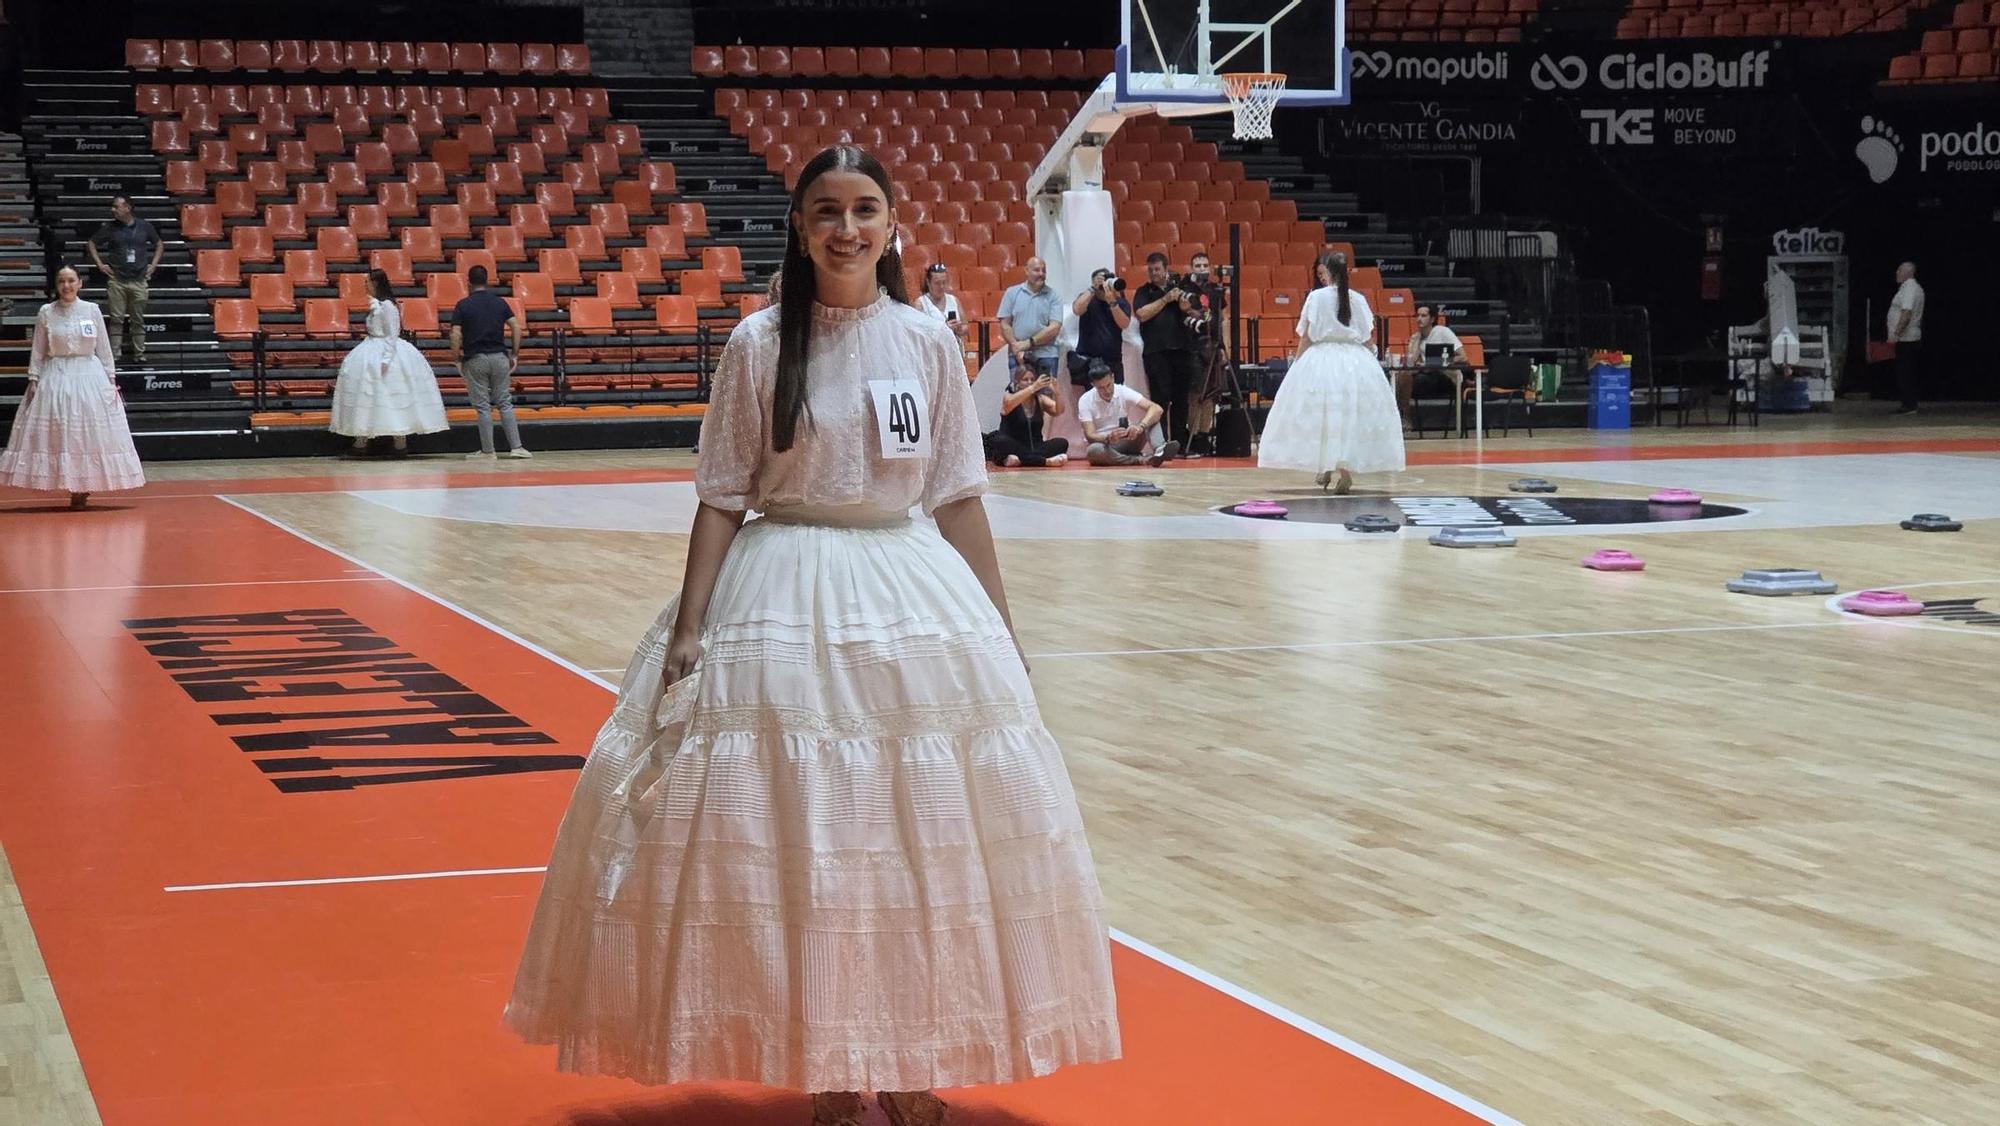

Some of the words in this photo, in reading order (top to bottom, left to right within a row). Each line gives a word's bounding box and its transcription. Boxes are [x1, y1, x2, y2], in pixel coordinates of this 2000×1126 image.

[1395, 51, 1508, 86] mapubli
[1599, 50, 1770, 90] CicloBuff
[1435, 118, 1516, 141] GANDIA
[1580, 108, 1655, 145] TKE
[1664, 108, 1706, 125] MOVE
[75, 138, 108, 152] Torres
[1674, 128, 1738, 146] BEYOND
[669, 141, 699, 152] Torres
[88, 178, 122, 191] Torres
[707, 179, 737, 191] Torres
[742, 219, 774, 231] Torres
[144, 375, 183, 391] Torres
[889, 392, 920, 443] 40
[120, 607, 589, 794] VALENCIA
